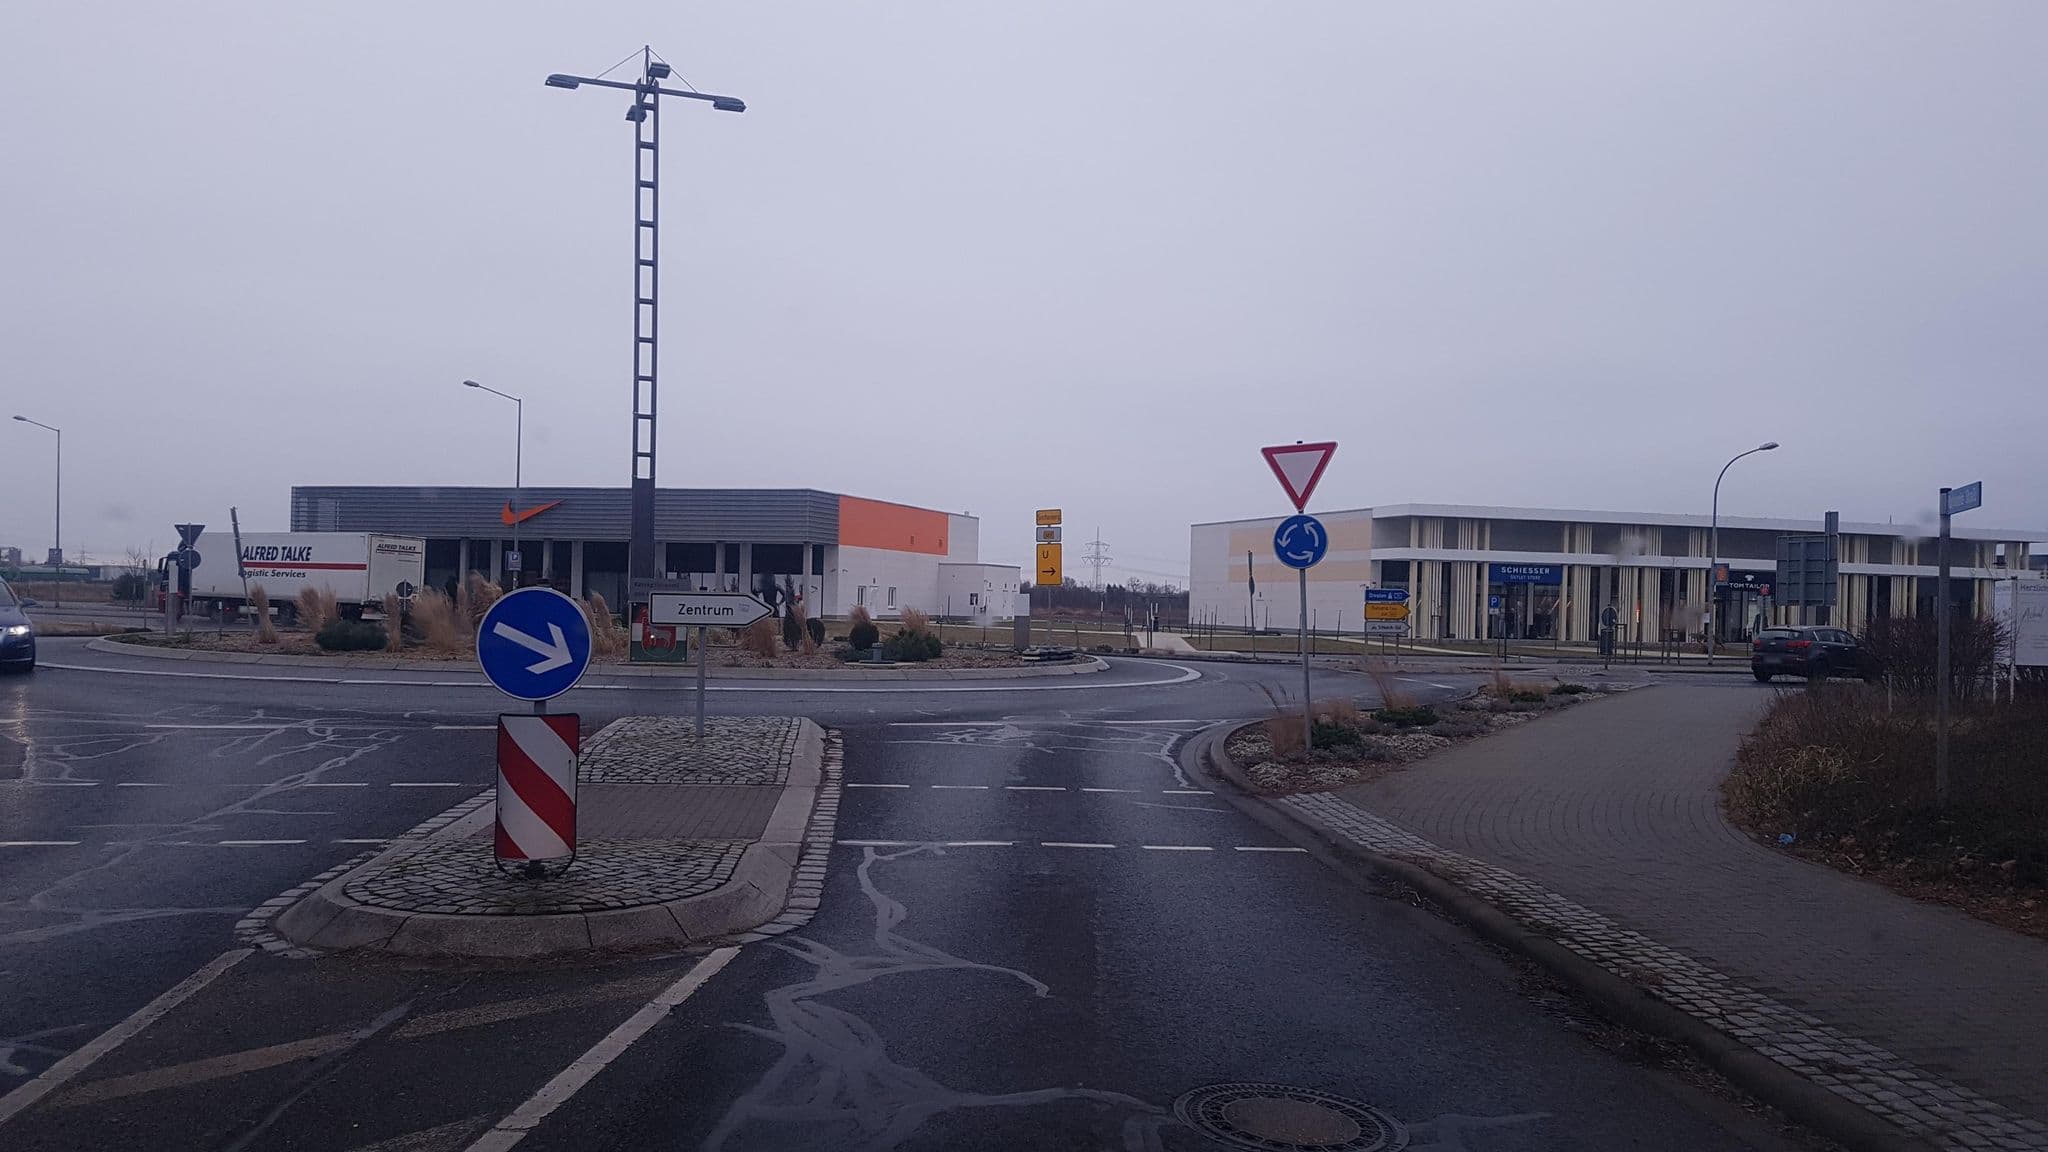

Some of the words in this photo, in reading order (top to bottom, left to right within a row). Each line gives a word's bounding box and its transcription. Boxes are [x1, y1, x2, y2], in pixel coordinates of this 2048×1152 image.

[242, 545, 278, 561] ALFRED
[281, 545, 313, 562] TALKE
[1042, 550, 1049, 559] U
[271, 569, 307, 578] Services
[1501, 566, 1550, 575] SCHIESSER
[1491, 597, 1498, 606] P
[678, 603, 734, 616] Zentrum
